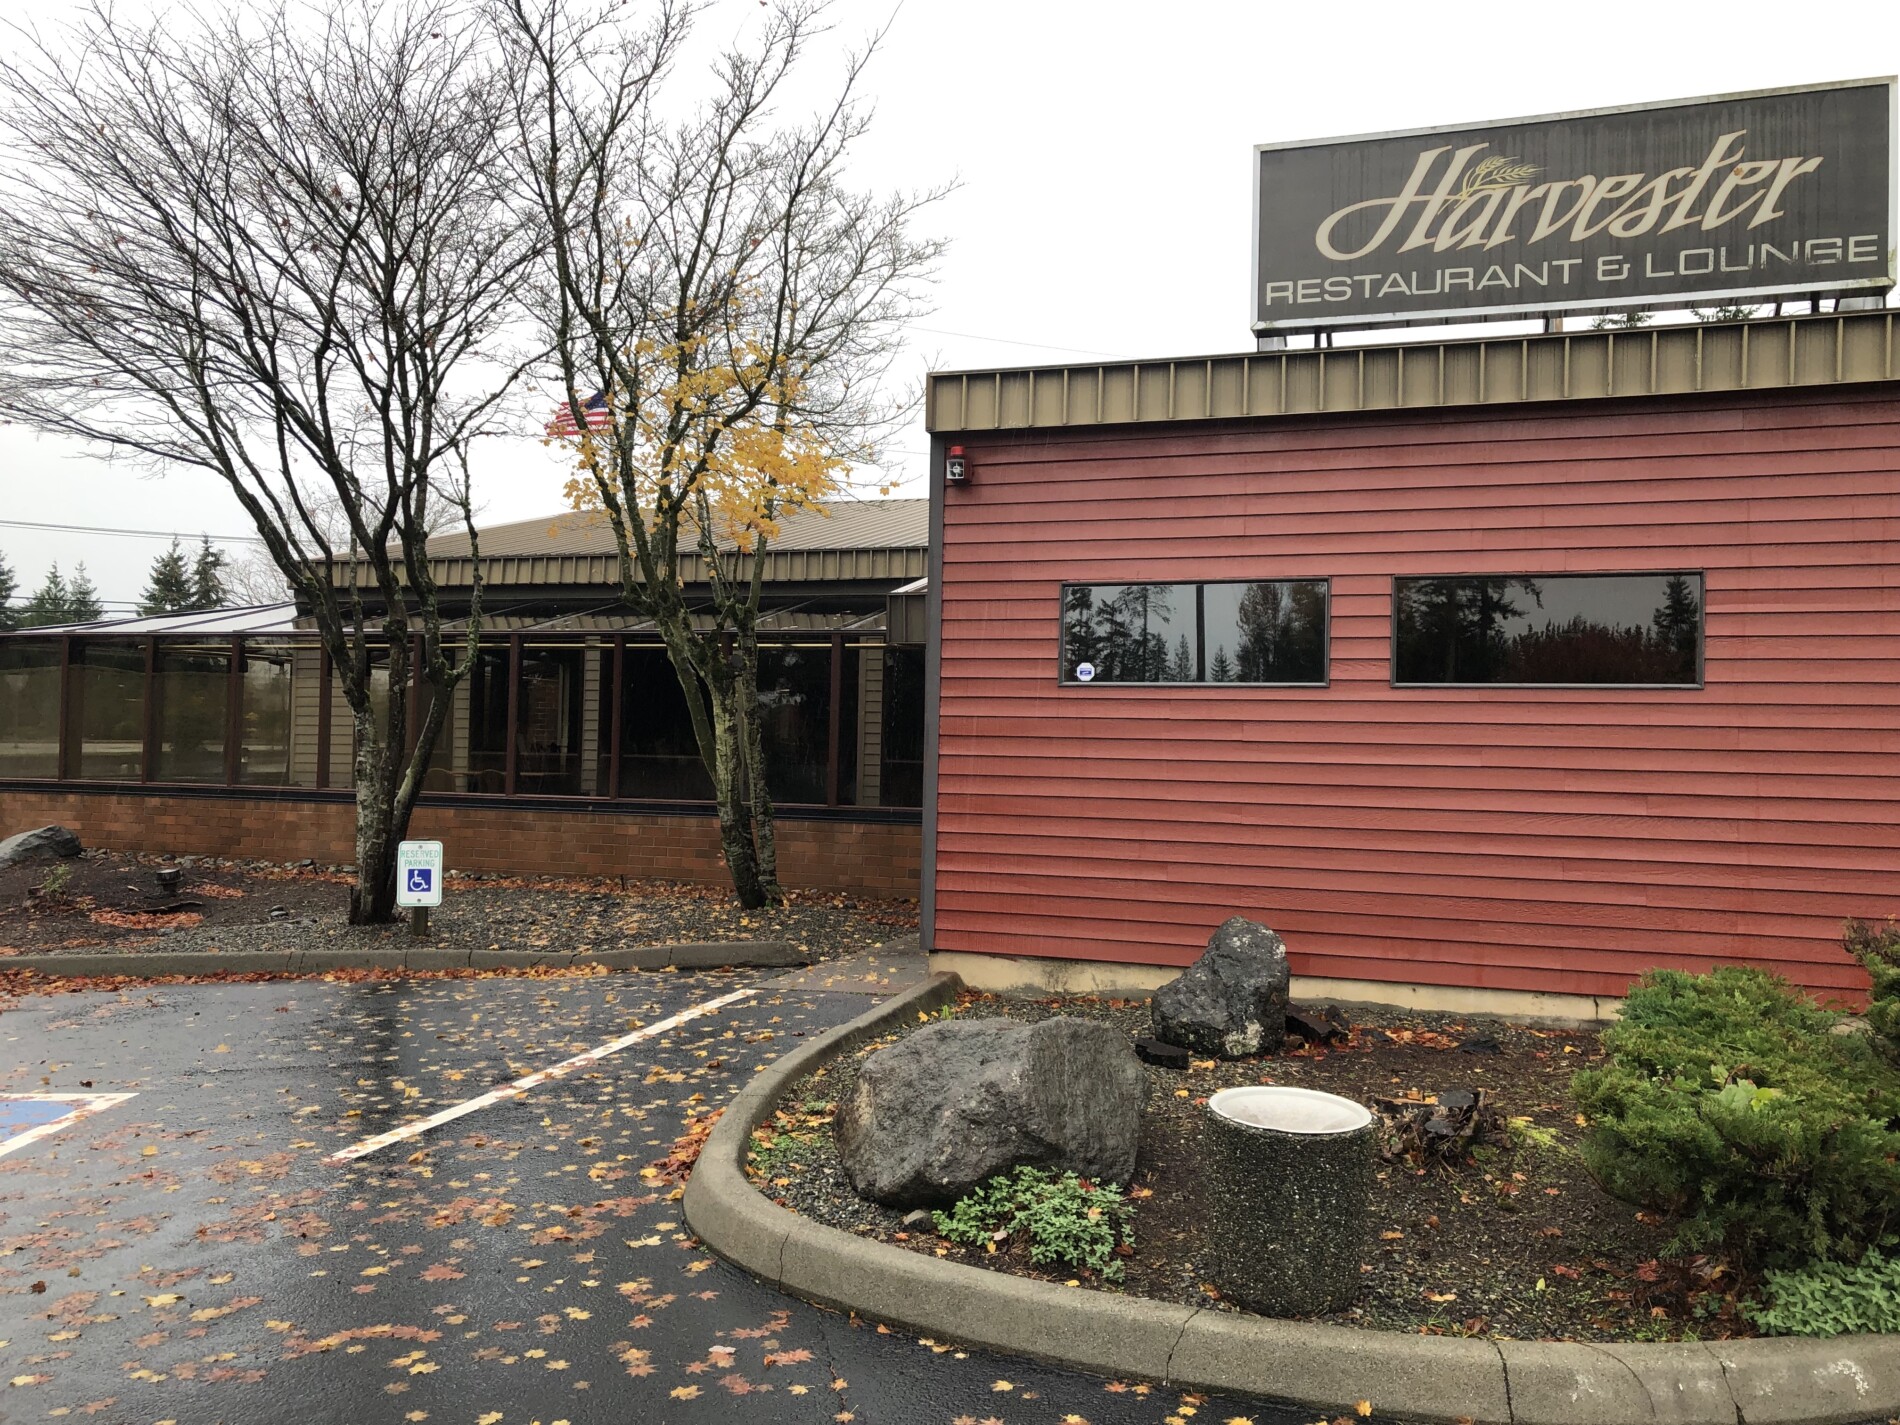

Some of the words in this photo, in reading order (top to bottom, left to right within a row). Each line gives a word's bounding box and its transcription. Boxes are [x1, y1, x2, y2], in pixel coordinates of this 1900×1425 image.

[1315, 129, 1825, 261] Harvester
[1266, 258, 1583, 306] RESTAURANT
[1598, 255, 1630, 281] &
[1646, 235, 1879, 278] LOUNGE
[400, 850, 439, 858] RESERVED
[404, 859, 435, 867] PARKING
